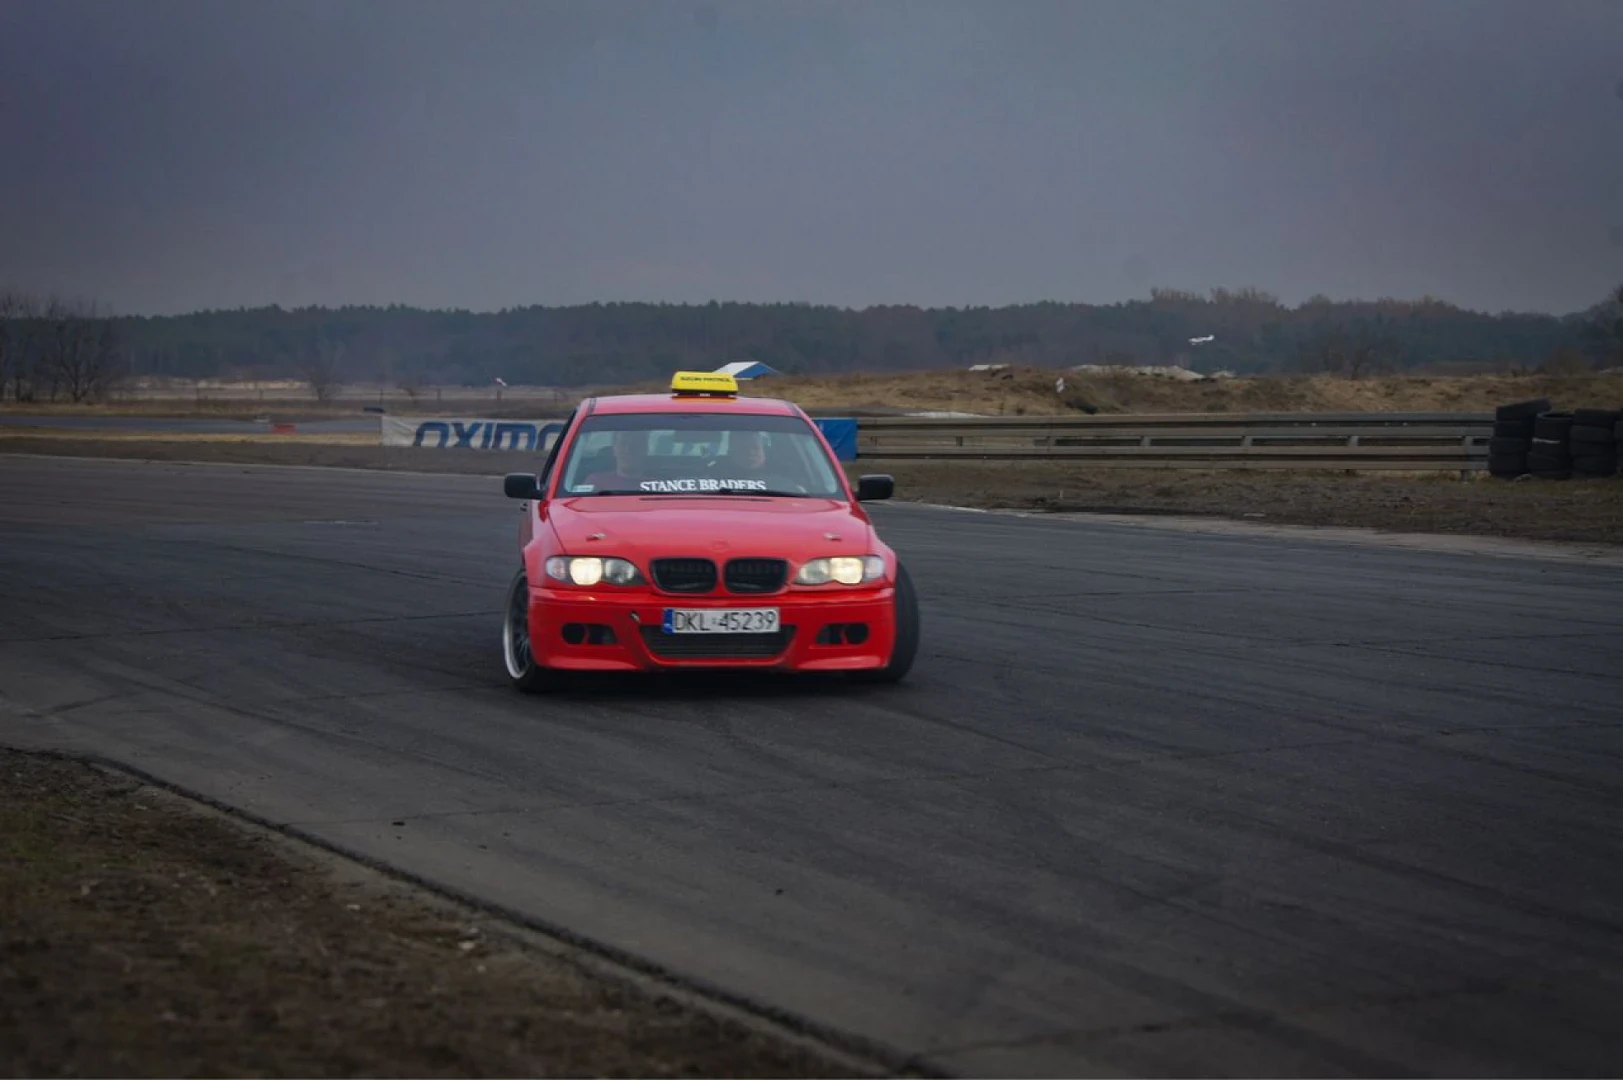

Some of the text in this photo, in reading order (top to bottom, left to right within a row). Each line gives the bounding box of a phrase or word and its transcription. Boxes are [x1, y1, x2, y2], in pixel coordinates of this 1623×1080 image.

[640, 478, 767, 492] STANCE BRADERS
[675, 610, 777, 631] DKL 45239
